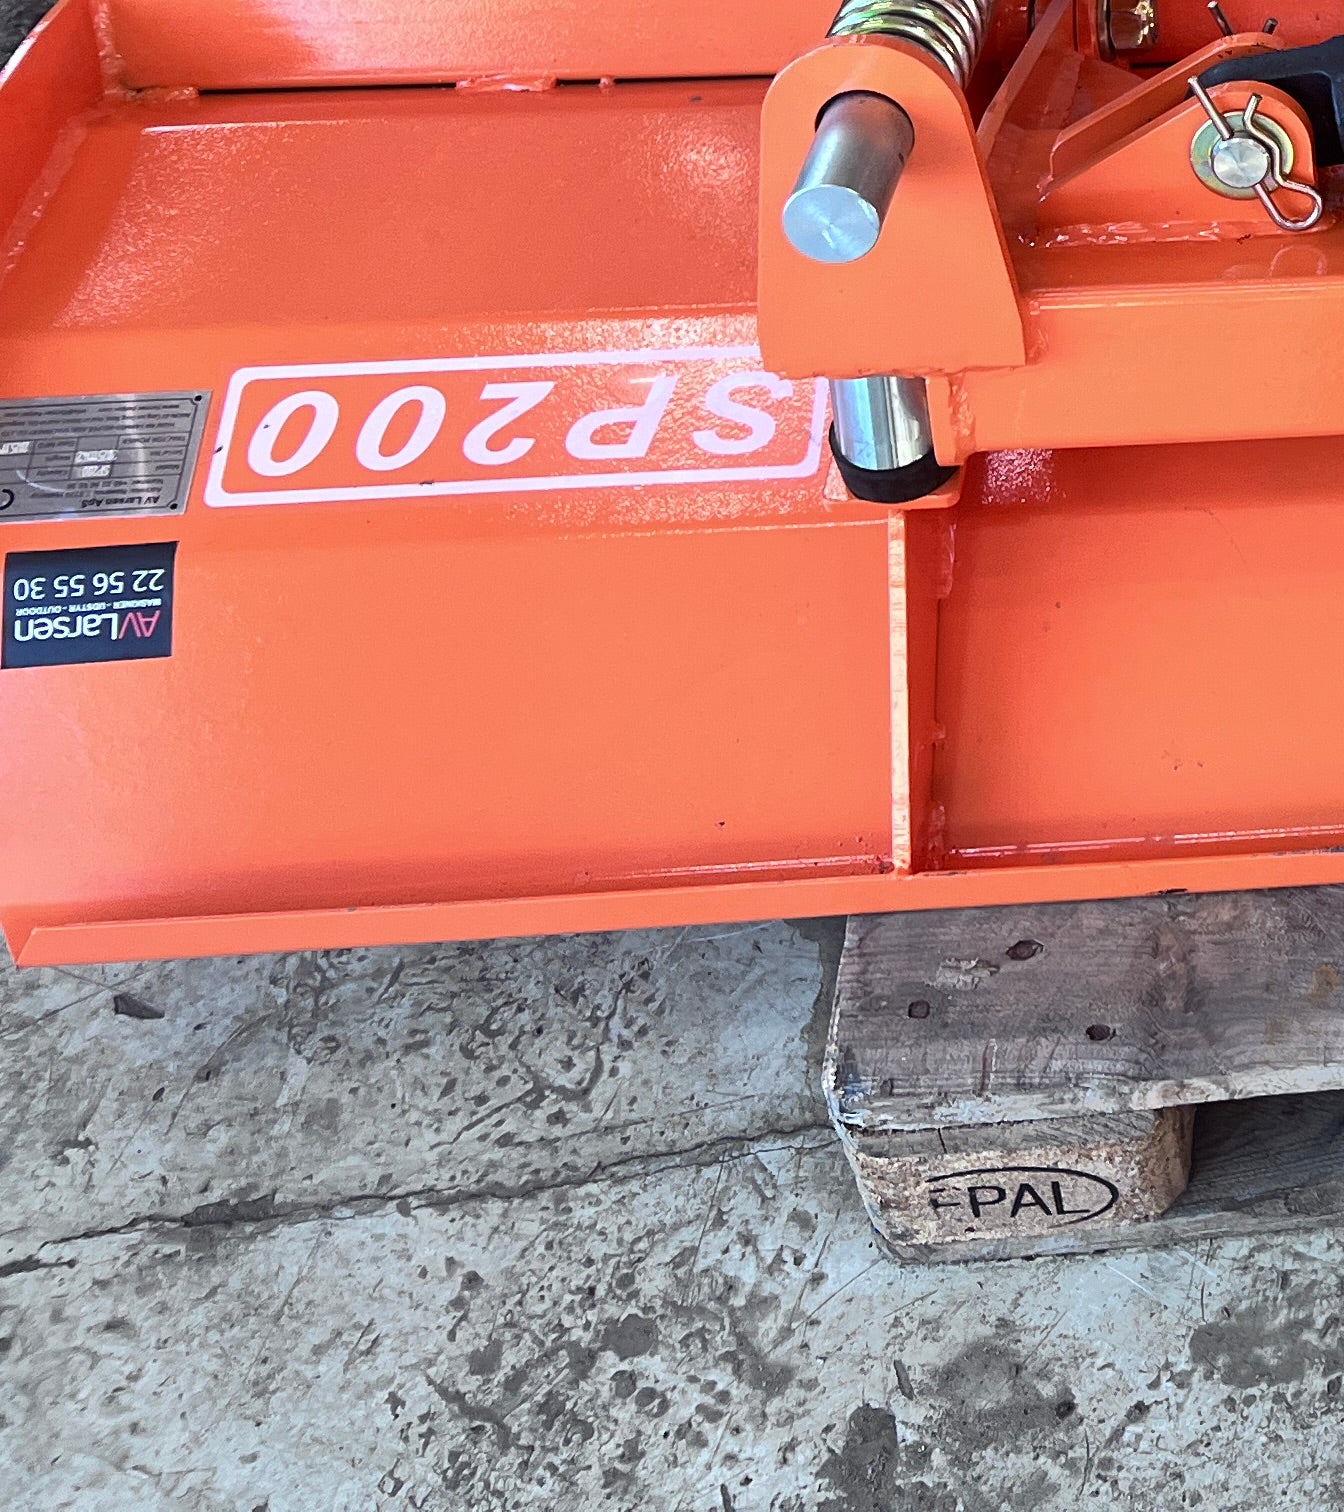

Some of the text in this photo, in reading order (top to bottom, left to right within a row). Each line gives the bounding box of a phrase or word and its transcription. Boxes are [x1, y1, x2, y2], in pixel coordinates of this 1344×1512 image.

[247, 371, 795, 477] SP200
[13, 568, 165, 601] 22 56 55 30
